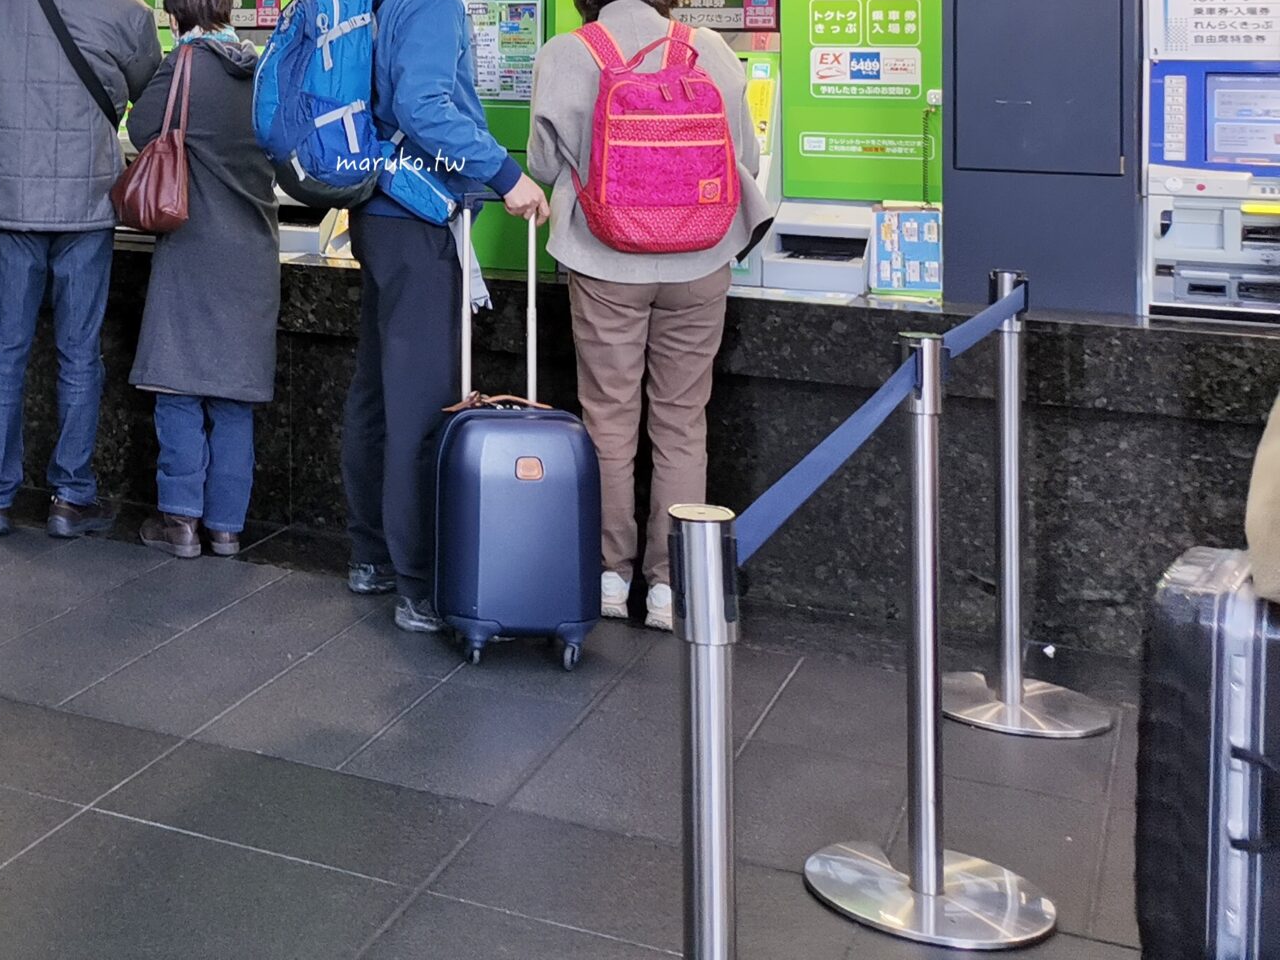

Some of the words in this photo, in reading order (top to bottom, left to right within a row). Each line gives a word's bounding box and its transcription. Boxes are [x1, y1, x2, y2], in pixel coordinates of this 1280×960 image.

[813, 10, 857, 20] トクトク
[871, 10, 916, 21] 乗車券
[814, 23, 857, 34] きっぷ
[871, 23, 916, 34] 入場券
[1193, 21, 1273, 30] れんらくきっぷ
[1193, 34, 1266, 44] 自由席特急券
[819, 53, 843, 65] EX
[850, 59, 880, 73] 5489
